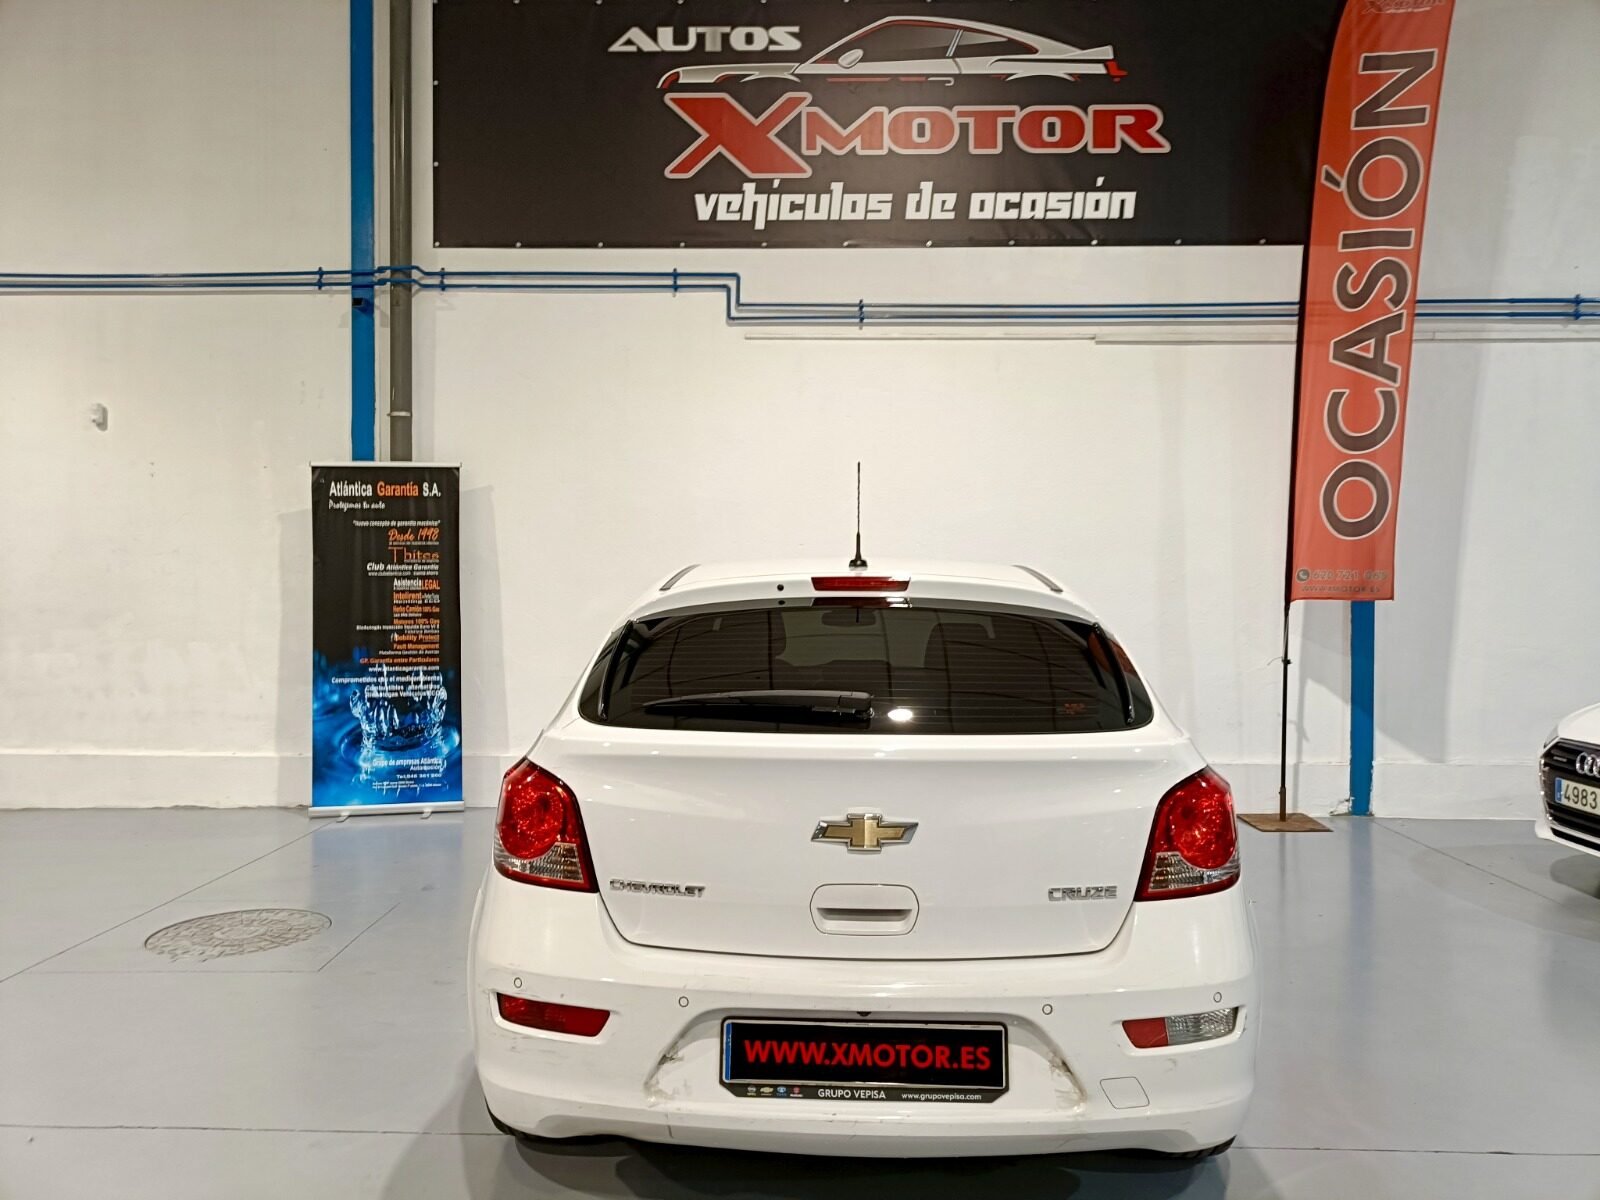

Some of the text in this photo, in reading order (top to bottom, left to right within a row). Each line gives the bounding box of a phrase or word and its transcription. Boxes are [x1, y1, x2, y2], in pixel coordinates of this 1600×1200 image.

[607, 26, 802, 52] AUTOS
[664, 92, 1171, 179] XMOTOR
[694, 176, 1137, 230] vehículos de ocasión
[1319, 48, 1438, 540] OCASIÓN
[329, 480, 373, 497] Atlántica
[376, 481, 419, 497] Garantía
[388, 527, 440, 541] Desde 1998
[366, 562, 385, 571] Club
[1564, 784, 1597, 809] 4983
[609, 879, 705, 898] CHEVROLET
[1047, 885, 1118, 901] CRUZE
[744, 1039, 991, 1070] WWW.XMOTOR.ES
[817, 1088, 852, 1099] GRUPO
[853, 1089, 887, 1100] VEPISA
[901, 1091, 983, 1101] www.grupovepisa.com
